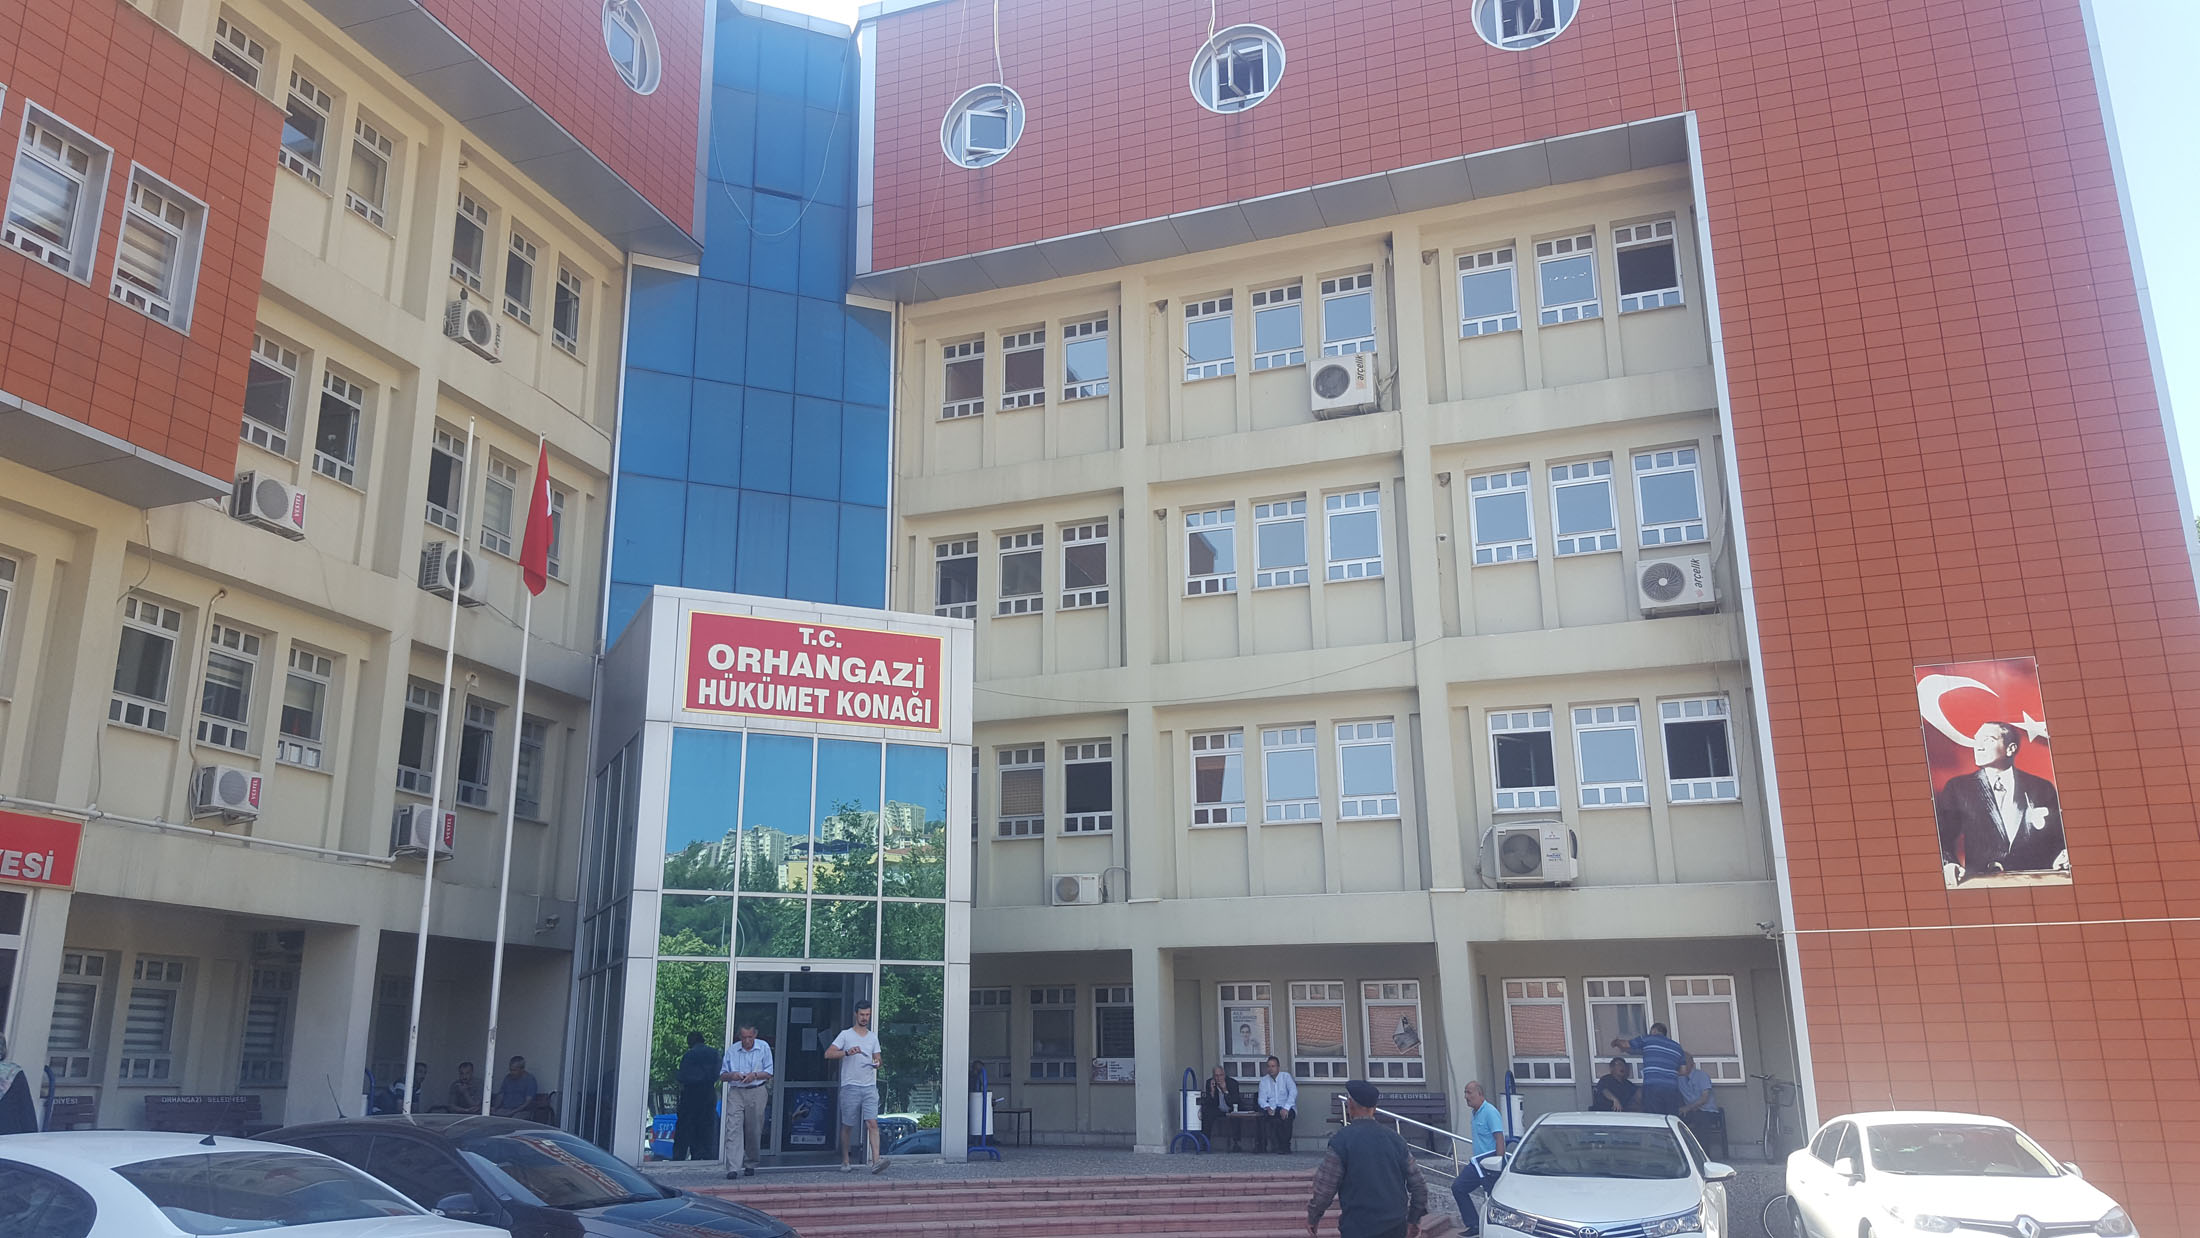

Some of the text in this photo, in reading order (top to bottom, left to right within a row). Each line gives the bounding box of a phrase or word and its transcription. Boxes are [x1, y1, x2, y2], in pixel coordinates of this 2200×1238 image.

[1691, 558, 1704, 588] arçelik
[799, 627, 842, 648] T.C.
[707, 643, 925, 689] ORHANGAZİ
[698, 672, 932, 723] HÜKÜMET KONAĞI
[0, 849, 54, 880] ESİ
